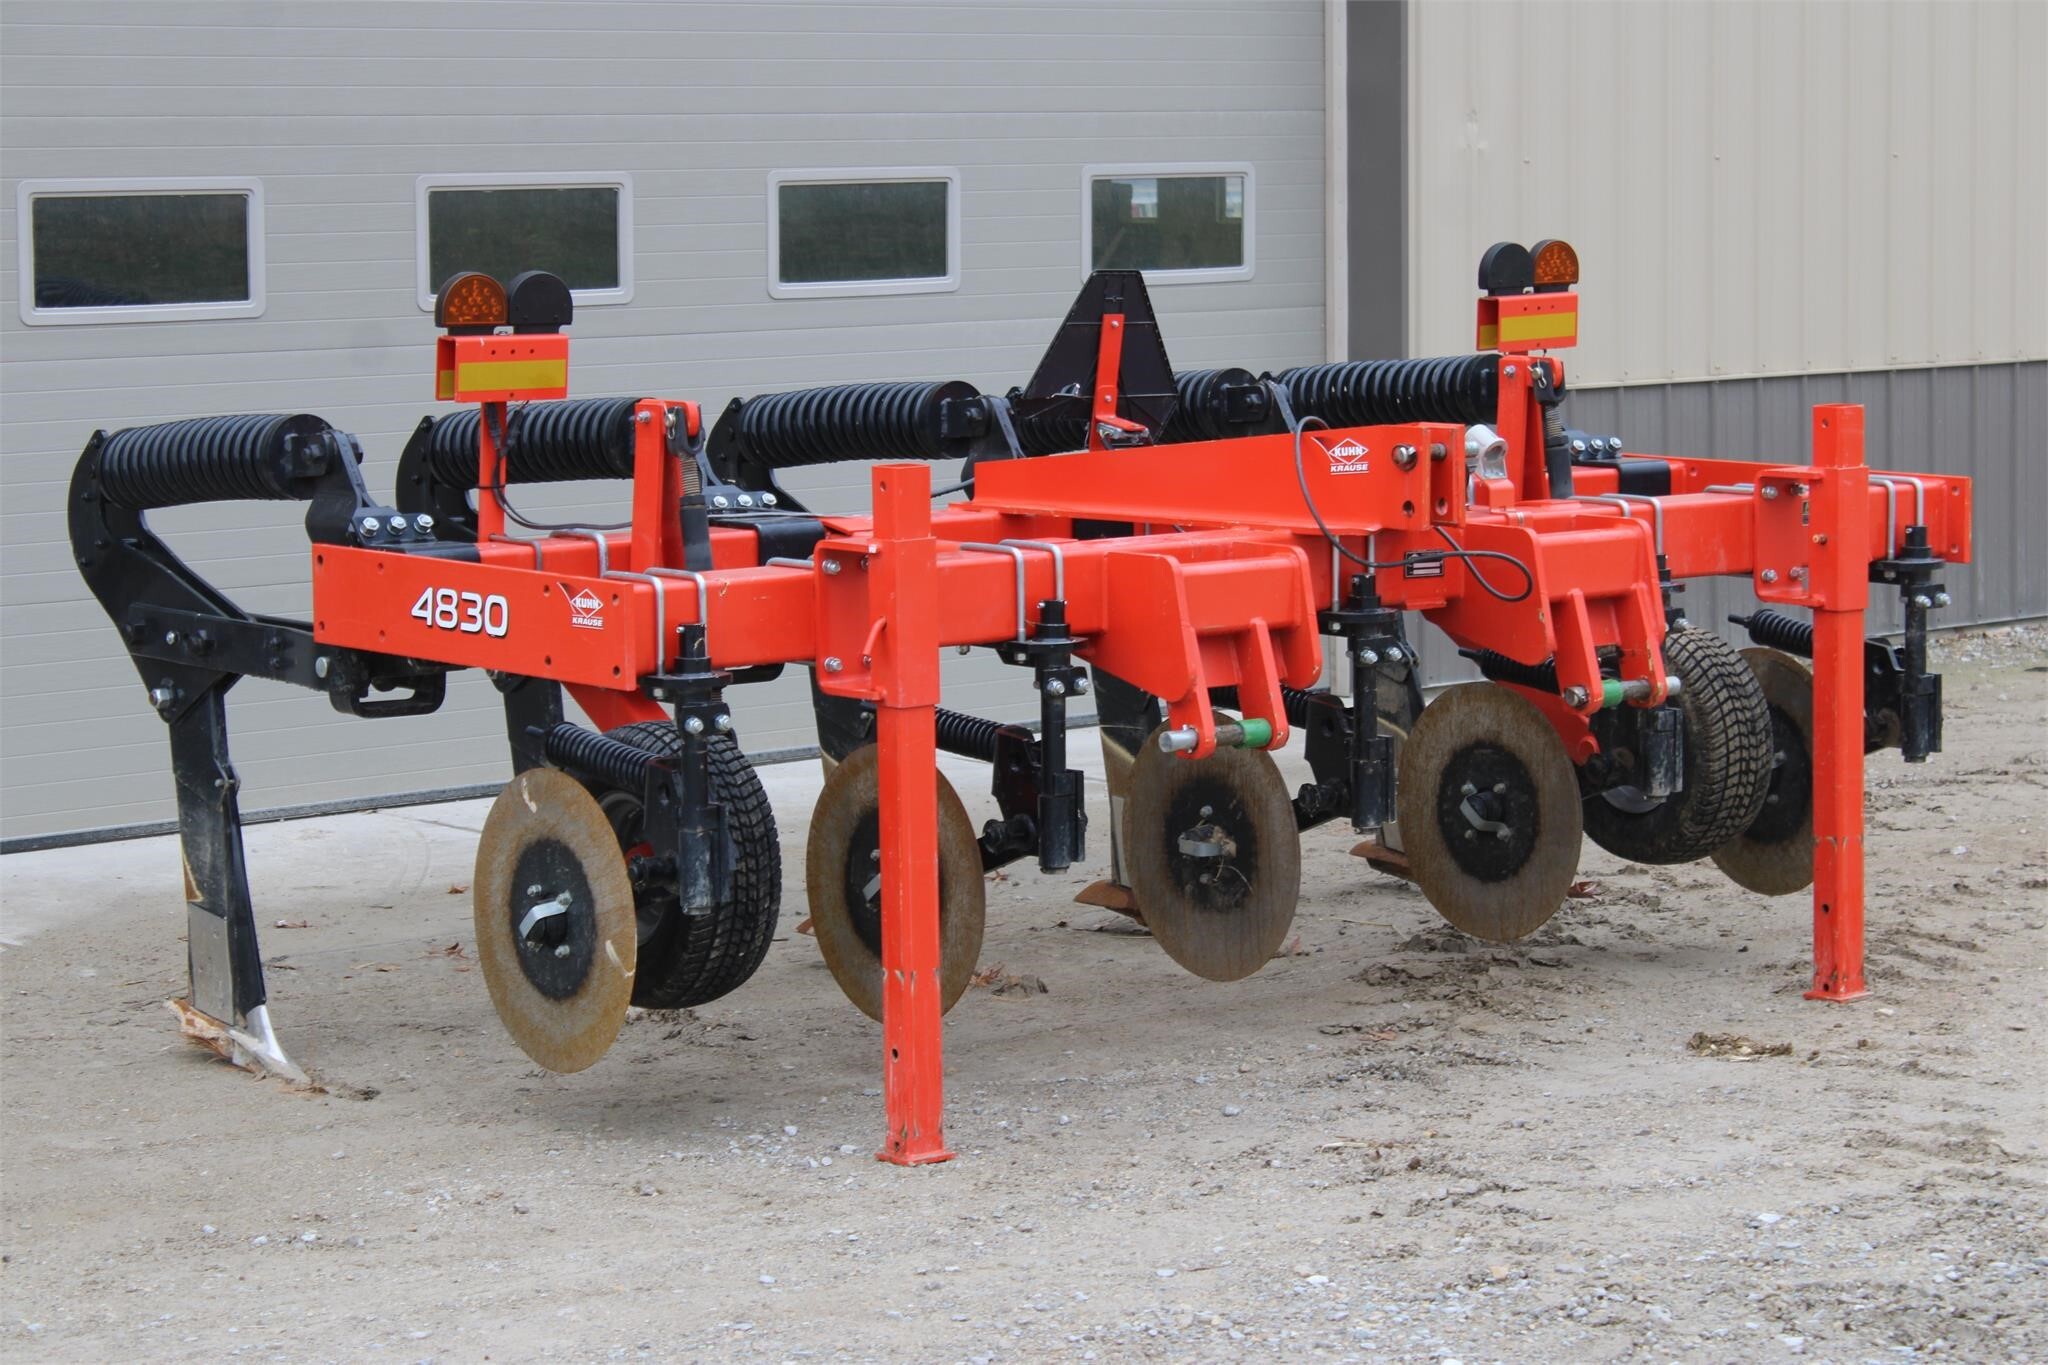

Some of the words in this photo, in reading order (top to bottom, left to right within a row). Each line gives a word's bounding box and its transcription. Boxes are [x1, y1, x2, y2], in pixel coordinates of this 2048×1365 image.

[1334, 446, 1363, 457] KUHN
[1330, 464, 1369, 472] KRAUSE
[575, 597, 599, 610] KUHN
[411, 587, 509, 638] 4830
[572, 617, 603, 627] KRAUSE
